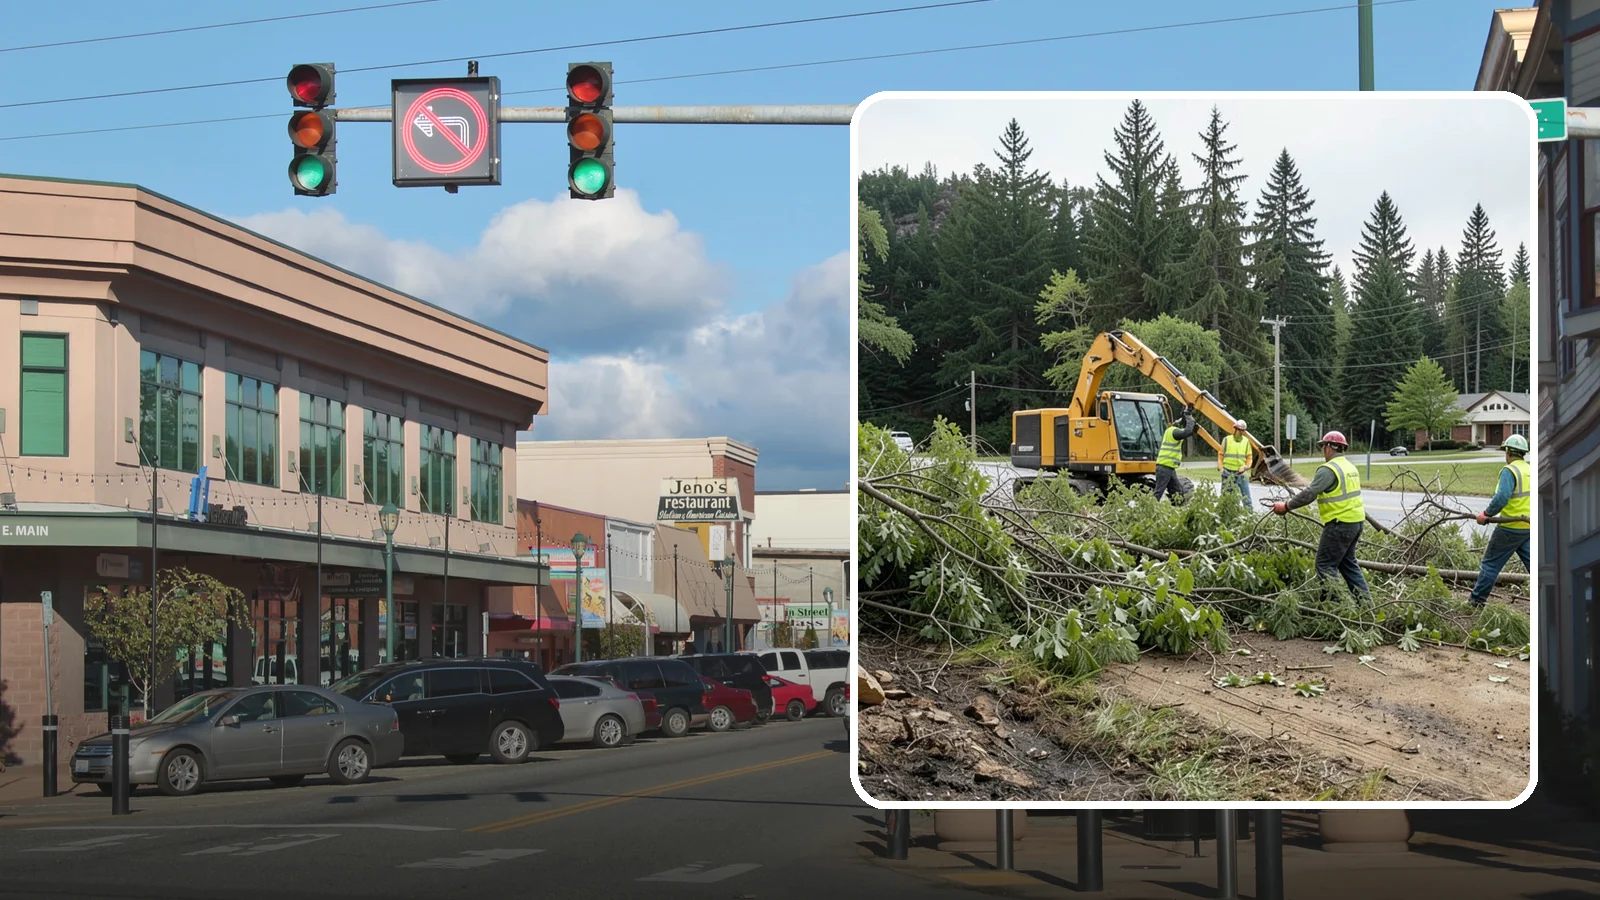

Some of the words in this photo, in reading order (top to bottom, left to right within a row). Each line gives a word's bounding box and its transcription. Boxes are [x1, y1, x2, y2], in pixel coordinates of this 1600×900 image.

[670, 480, 727, 494] Jeno's
[665, 496, 731, 509] restaurant
[659, 510, 681, 519] Italian
[686, 509, 714, 519] American
[715, 509, 738, 519] Cuisine
[2, 525, 13, 536] E.
[15, 525, 49, 536] MAIN
[797, 607, 828, 616] Street
